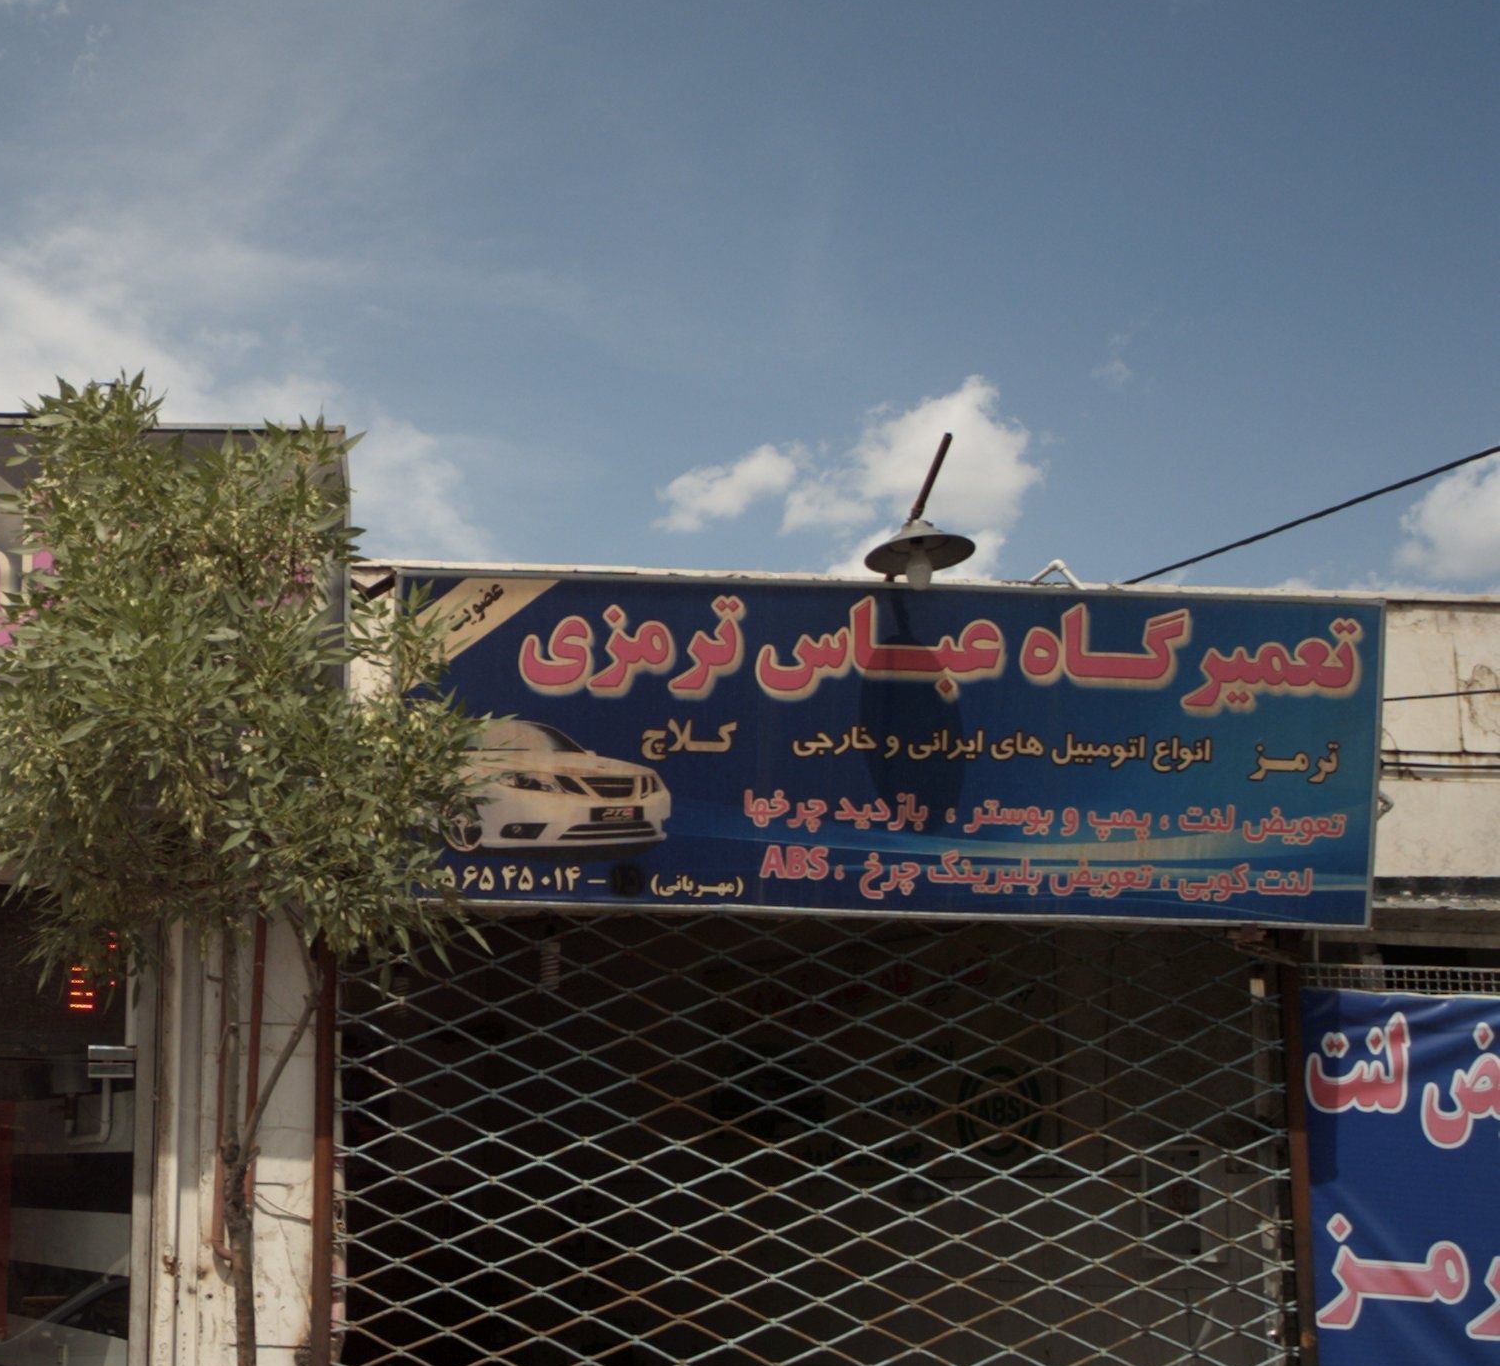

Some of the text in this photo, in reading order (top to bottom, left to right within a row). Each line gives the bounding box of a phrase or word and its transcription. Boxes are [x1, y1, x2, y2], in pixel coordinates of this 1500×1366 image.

[518, 596, 745, 701] ترمزی
[756, 596, 1006, 702] عباس
[640, 718, 1340, 784] ترمز انواع اتومبیل های ایرانی و خارجی کلاچ
[743, 788, 829, 833] چرخها
[836, 791, 928, 831] بازدید
[1061, 811, 1080, 836] و
[1086, 809, 1152, 842] پمپ
[1242, 806, 1347, 842] تعویض
[760, 845, 830, 880] ABS
[927, 850, 1043, 896] بلبرینگ
[1050, 862, 1154, 900] تعویض
[1256, 866, 1314, 897] لنت
[650, 873, 744, 899] (مهربانی)
[1305, 1010, 1412, 1114] لنت
[1315, 1213, 1500, 1340] رمز
